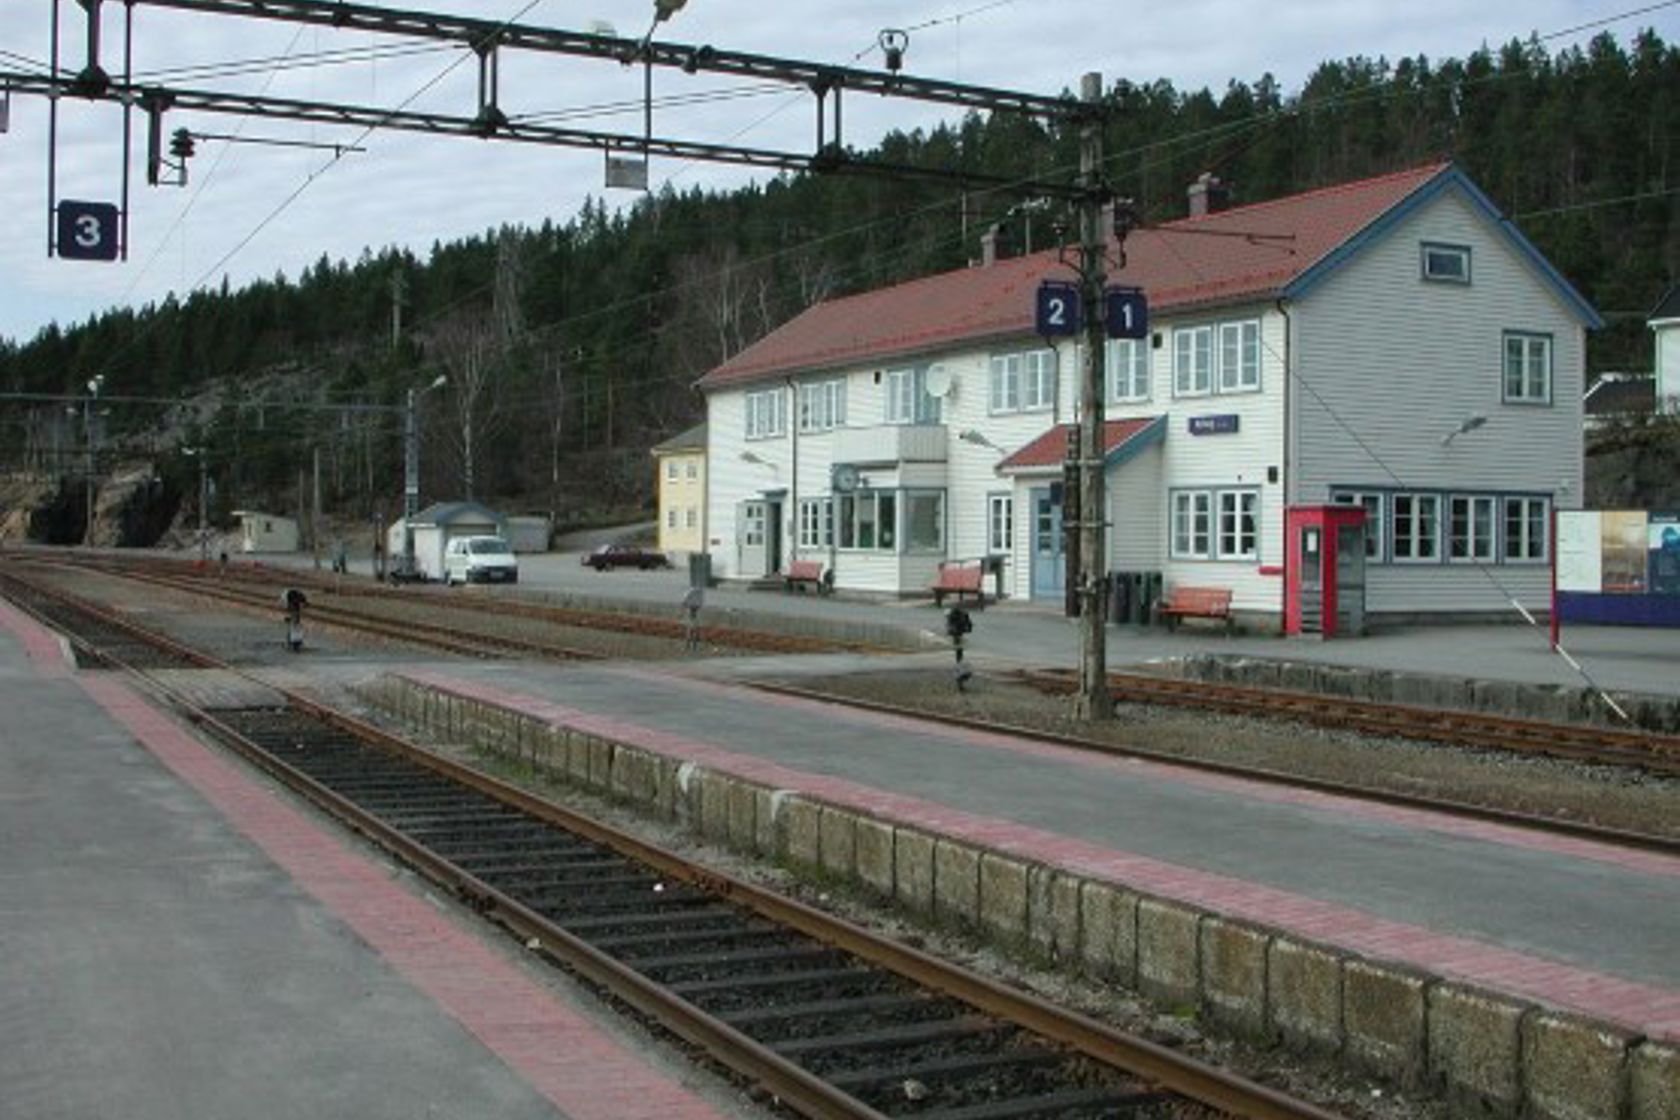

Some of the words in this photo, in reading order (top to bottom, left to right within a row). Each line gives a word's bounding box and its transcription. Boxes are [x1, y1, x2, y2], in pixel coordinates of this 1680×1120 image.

[75, 214, 101, 247] 3
[1048, 298, 1065, 325] 2
[1122, 303, 1133, 330] 1
